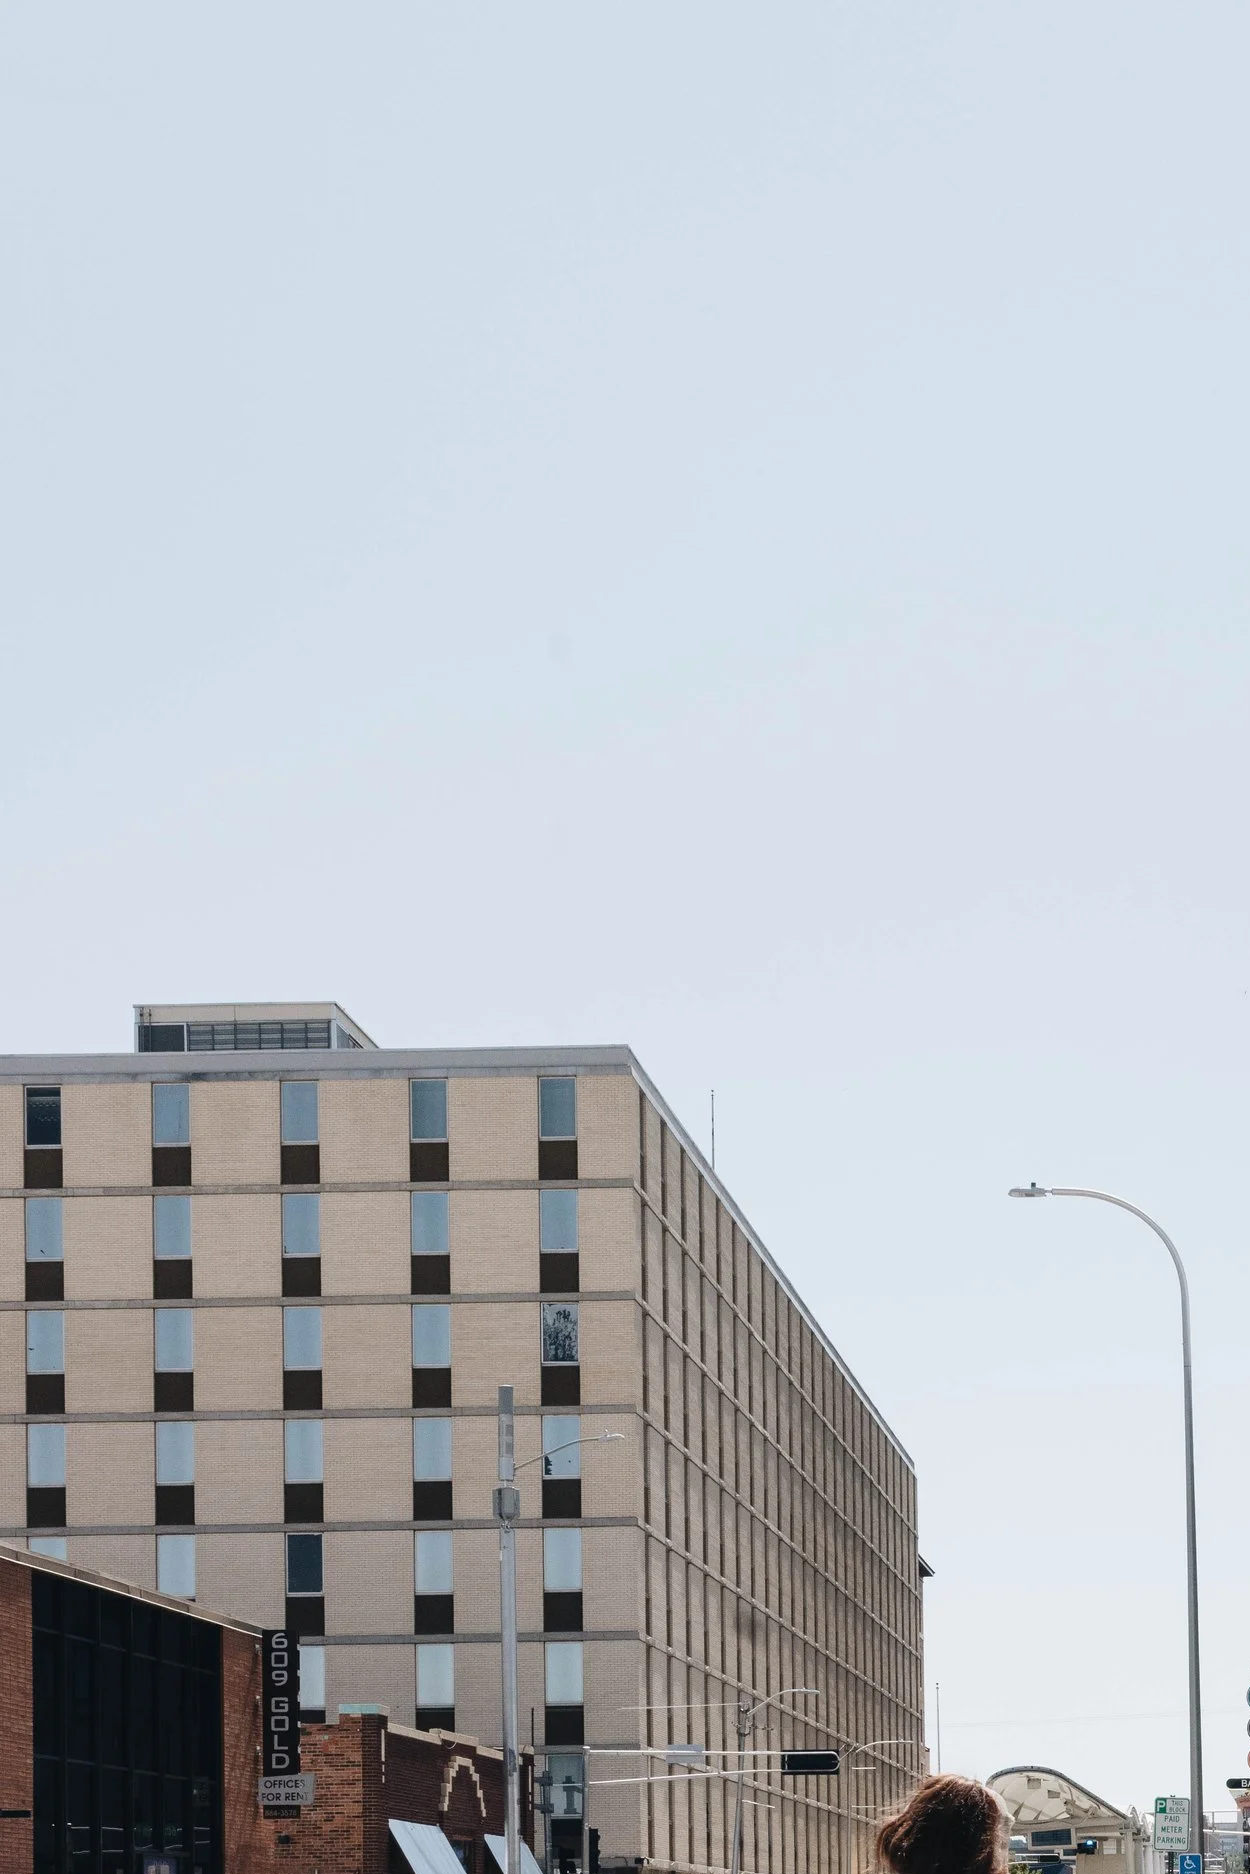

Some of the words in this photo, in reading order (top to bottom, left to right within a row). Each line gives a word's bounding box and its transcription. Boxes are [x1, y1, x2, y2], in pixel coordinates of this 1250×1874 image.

[271, 1633, 289, 1686] 609
[270, 1697, 290, 1769] GOLD
[264, 1780, 305, 1789] OFFICES
[261, 1792, 281, 1802] FOR
[284, 1792, 309, 1801] RENT
[1156, 1800, 1166, 1812] P
[1164, 1815, 1180, 1823] PAID
[1160, 1826, 1183, 1834] METER
[1156, 1836, 1186, 1845] PARKING
